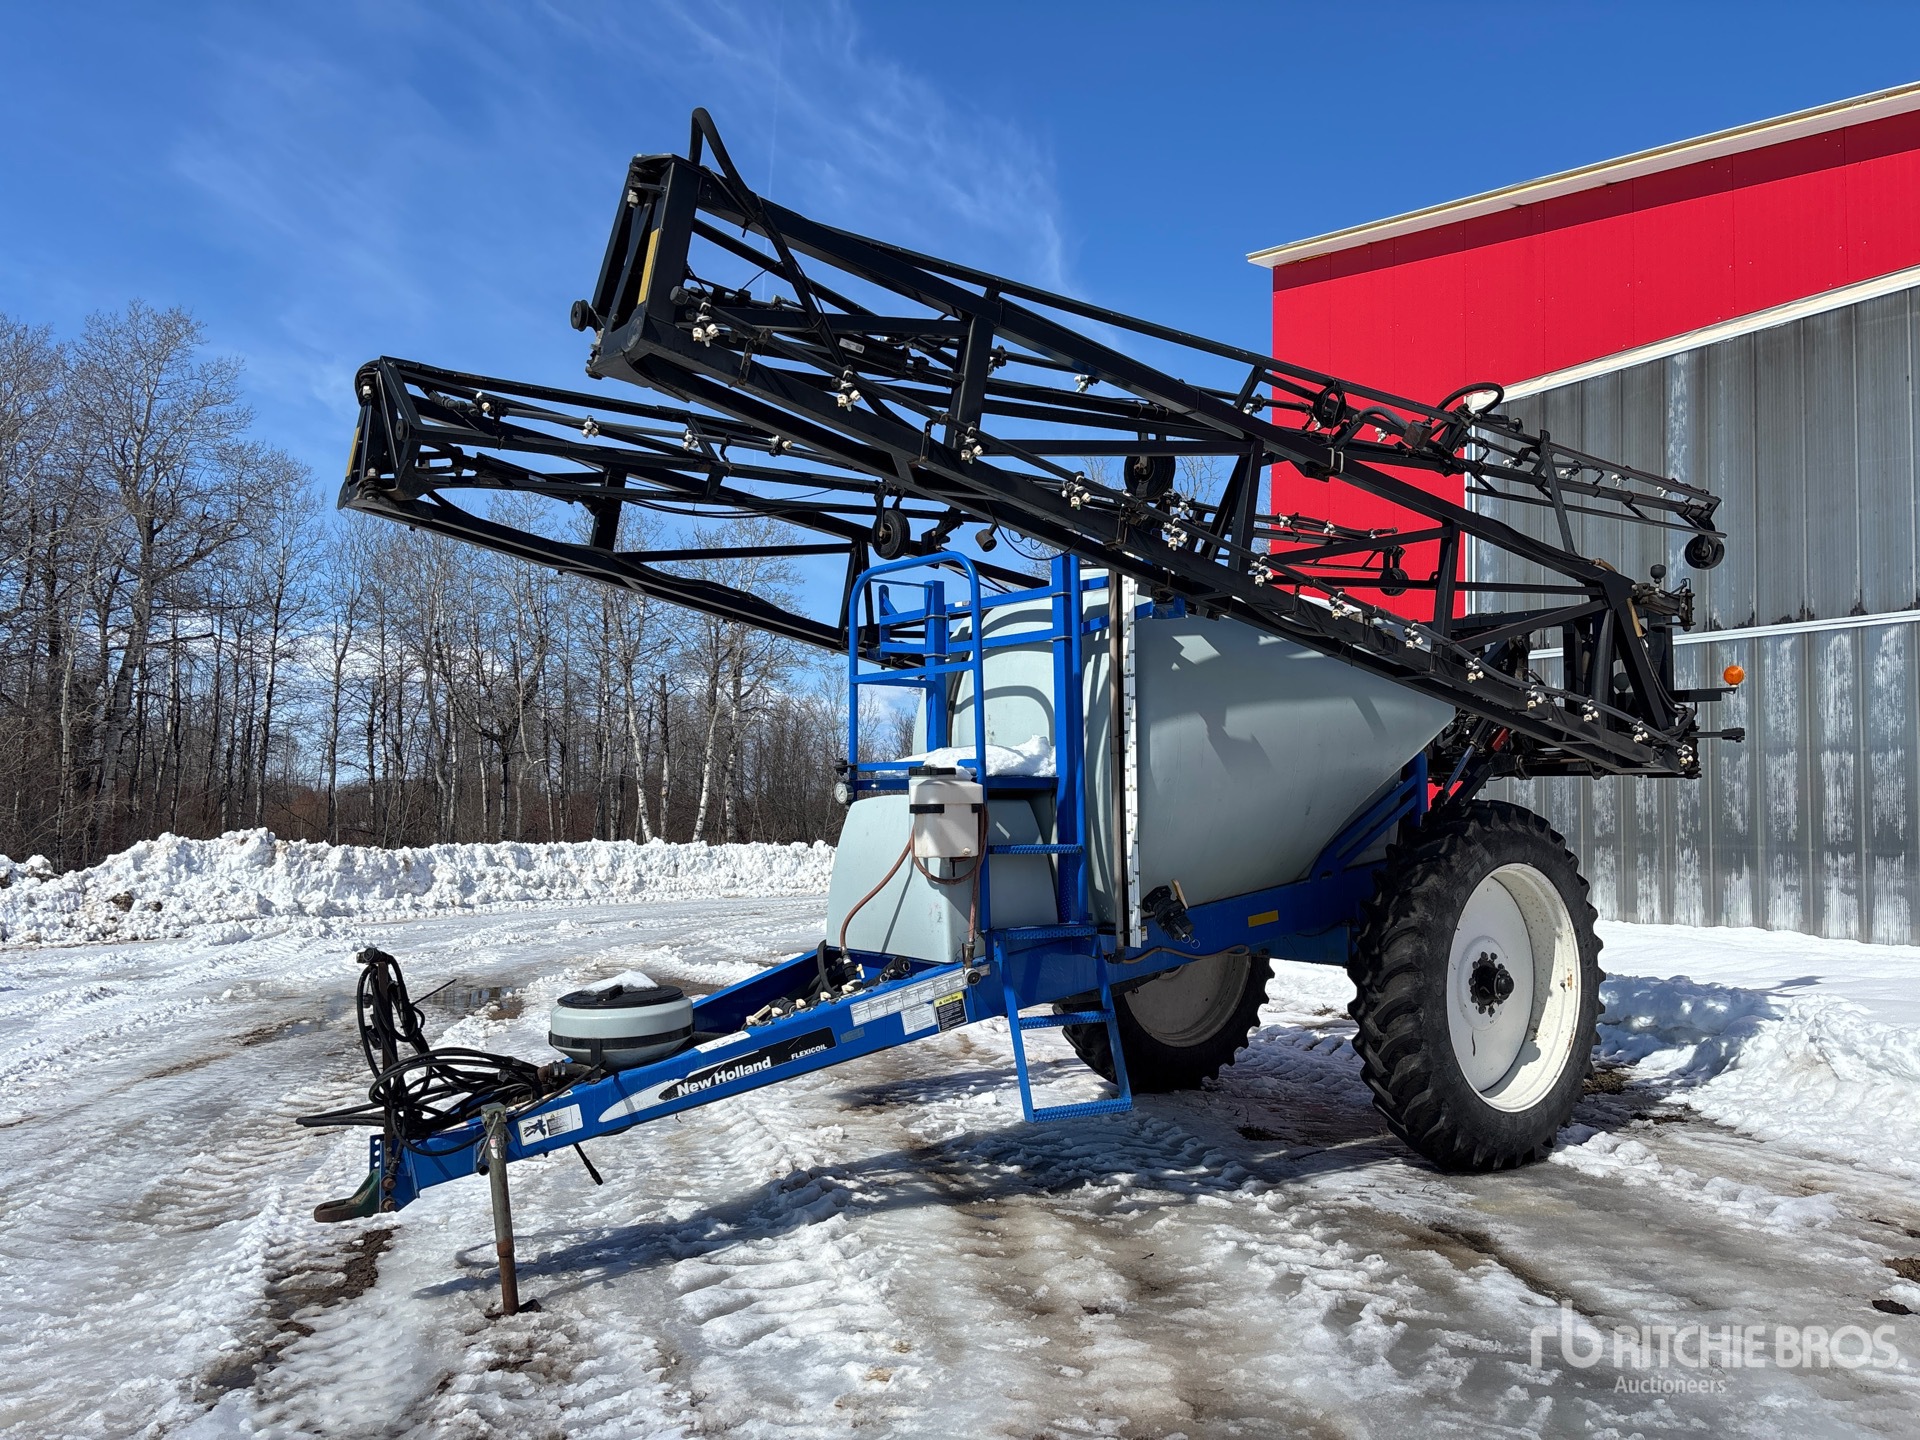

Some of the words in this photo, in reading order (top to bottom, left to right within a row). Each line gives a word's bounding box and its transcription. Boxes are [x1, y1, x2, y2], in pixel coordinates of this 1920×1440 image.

[791, 1043, 828, 1060] FLEXICOIL
[677, 1077, 713, 1097] New
[714, 1056, 772, 1084] Holland
